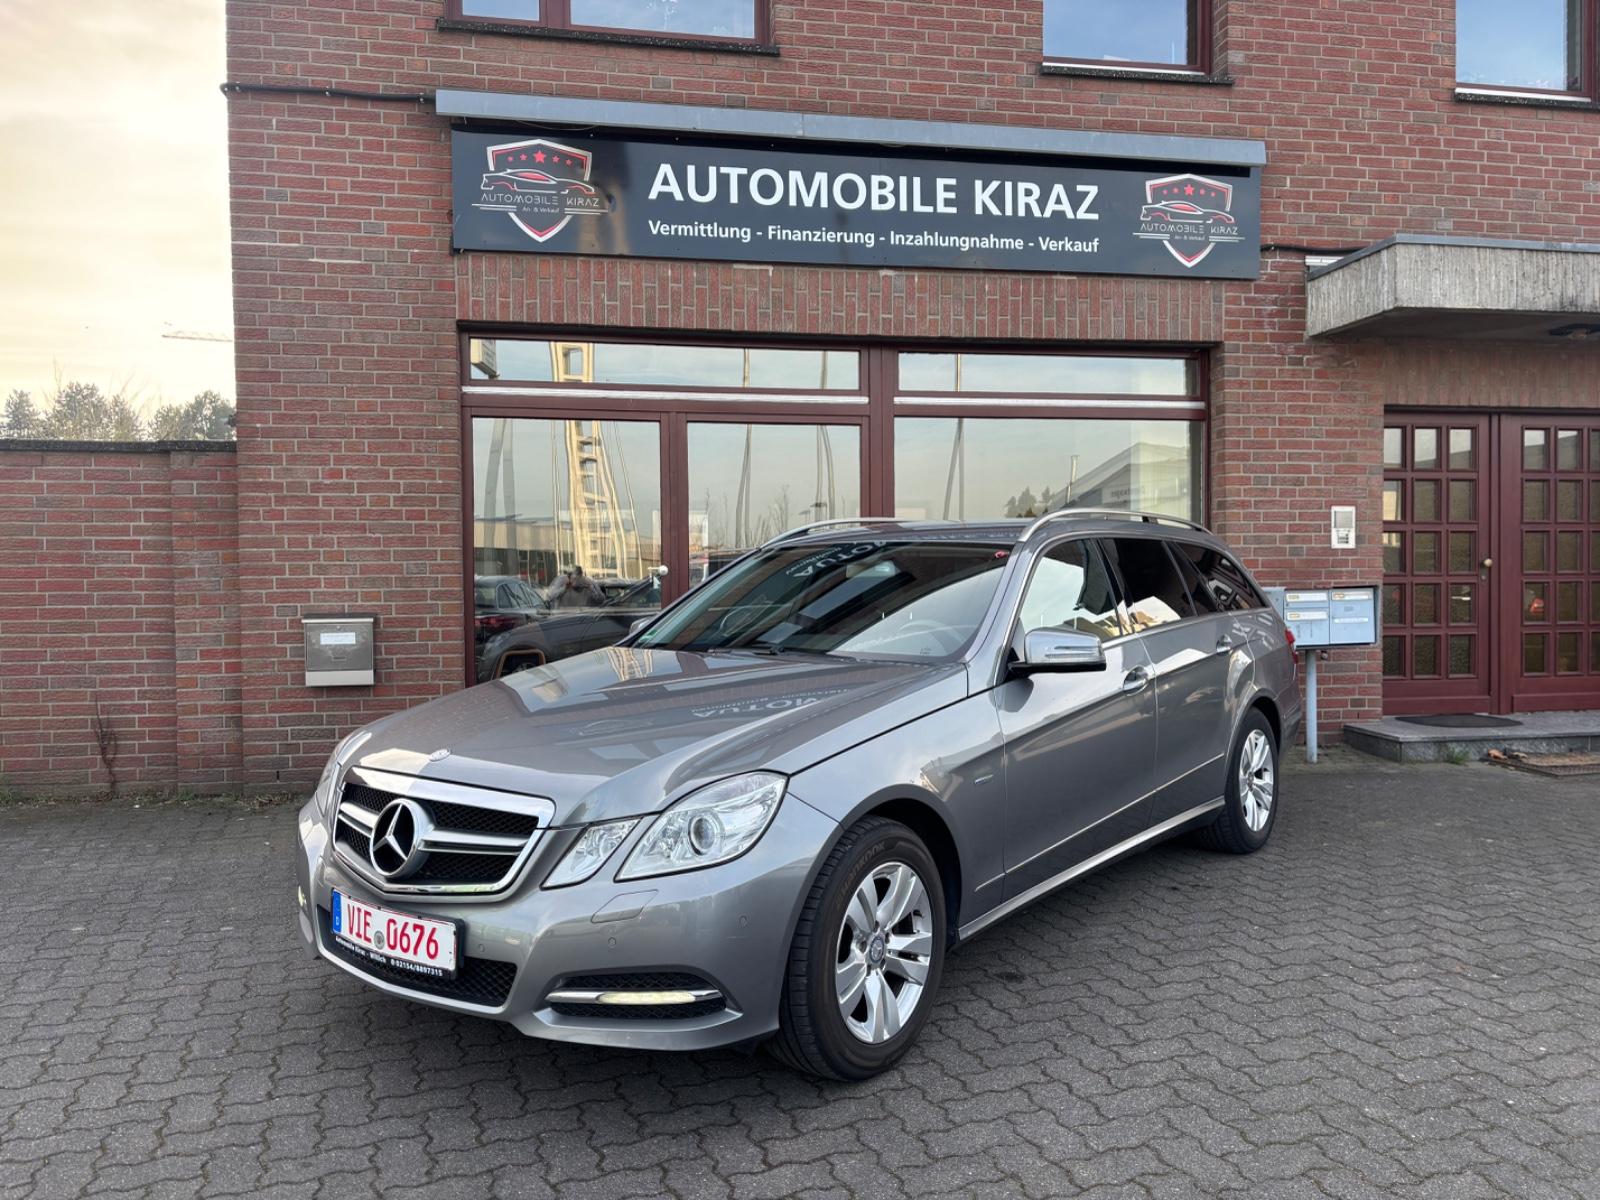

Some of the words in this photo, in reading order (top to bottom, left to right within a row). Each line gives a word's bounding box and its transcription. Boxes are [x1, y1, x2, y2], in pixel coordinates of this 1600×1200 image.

[481, 193, 559, 206] AUTOMOBILE
[566, 197, 600, 207] KIRAZ
[648, 163, 957, 214] AUTOMOBILE
[974, 179, 1099, 220] KIRAZ
[648, 220, 751, 243] Vermittlung
[768, 225, 875, 248] Finanzierung
[890, 230, 1024, 251] Inzahlungnahme
[1038, 236, 1100, 253] Verkauf
[1140, 223, 1205, 234] AUTOMOBILE
[1210, 226, 1238, 236] KIRAZ
[347, 903, 372, 944] VIE
[386, 918, 439, 960] 0676
